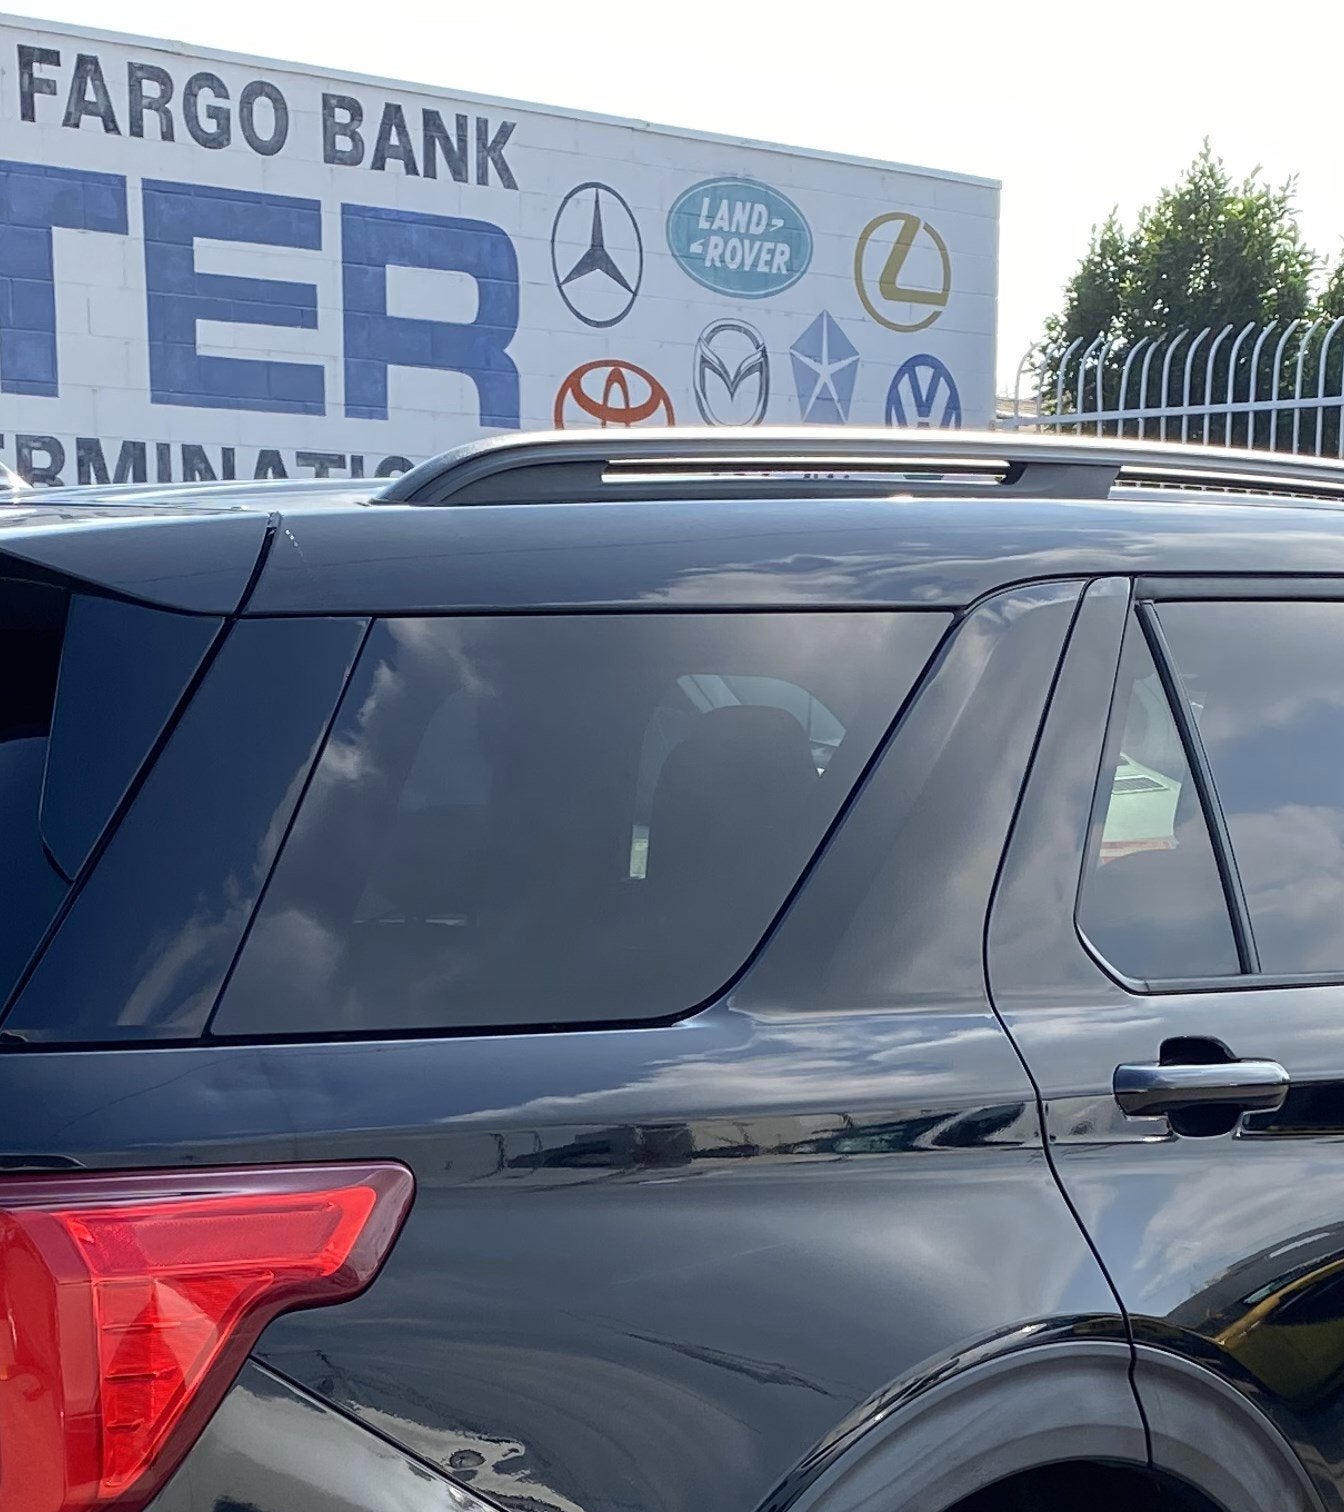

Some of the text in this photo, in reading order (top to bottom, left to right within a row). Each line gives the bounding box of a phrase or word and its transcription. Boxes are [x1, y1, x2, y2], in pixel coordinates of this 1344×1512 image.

[17, 43, 289, 156] FARGO
[321, 91, 519, 191] BANK
[698, 197, 768, 235] LAND
[705, 235, 791, 275] ROVER
